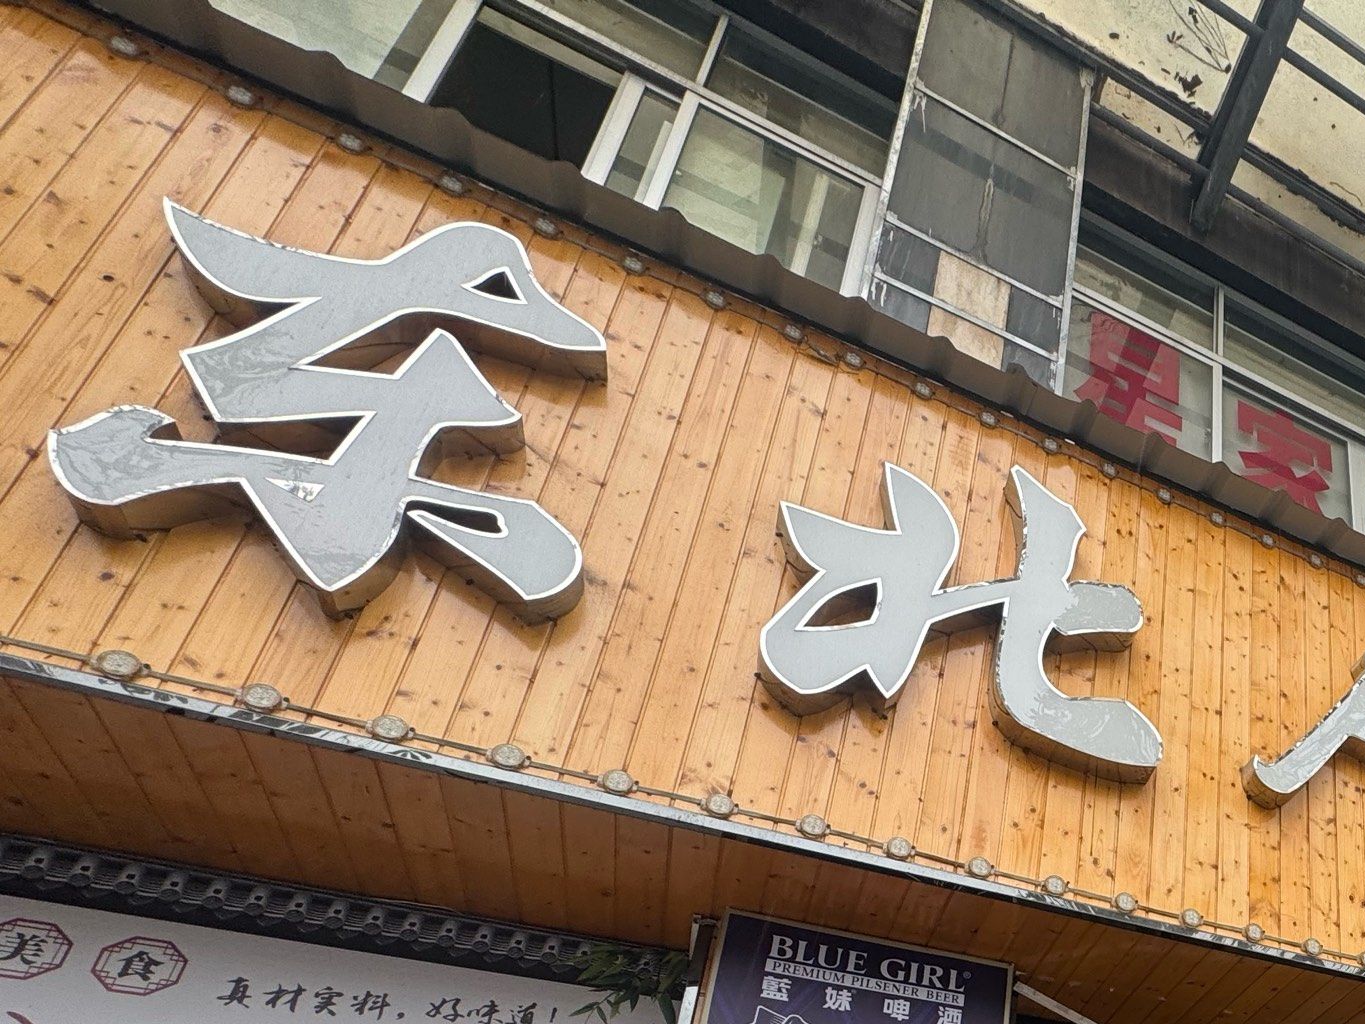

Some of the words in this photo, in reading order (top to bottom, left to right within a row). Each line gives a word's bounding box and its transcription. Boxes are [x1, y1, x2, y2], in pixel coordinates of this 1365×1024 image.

[0, 930, 162, 983] 美食
[769, 933, 870, 974] BLUE
[879, 956, 967, 991] GIRL
[770, 959, 847, 985] PREMIUM
[849, 972, 921, 998] PILSENER
[924, 988, 962, 1005] BEER
